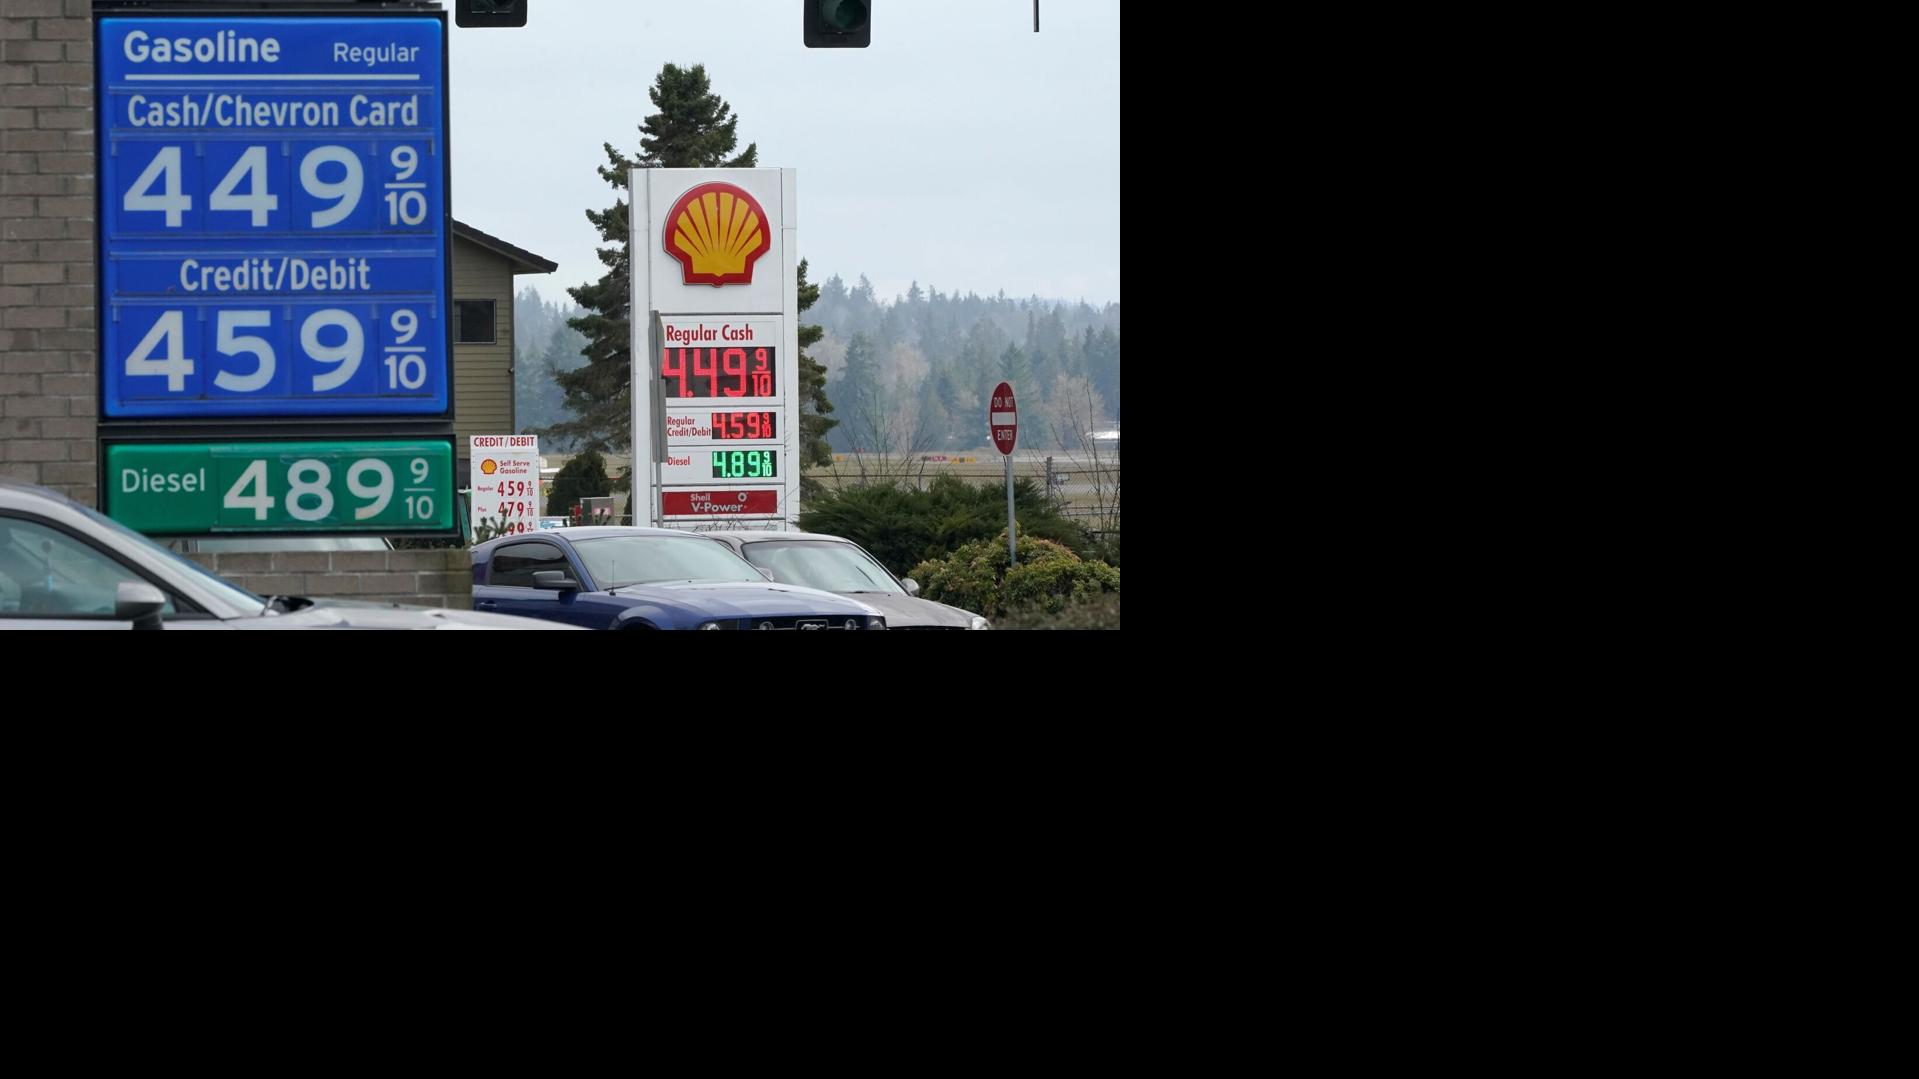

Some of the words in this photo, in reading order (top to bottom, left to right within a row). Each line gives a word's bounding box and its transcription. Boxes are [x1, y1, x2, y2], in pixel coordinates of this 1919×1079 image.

[123, 30, 280, 63] Gasoline
[333, 42, 420, 66] Regular
[127, 93, 339, 127] Cash/Chevron
[350, 95, 419, 127] Card
[123, 145, 365, 228] 449
[179, 257, 371, 291] Credit/Debit
[666, 324, 718, 345] Regular
[722, 323, 753, 341] Cash
[125, 308, 365, 392] 459
[994, 397, 1003, 408] DO
[1004, 397, 1014, 408] NOT
[667, 416, 696, 427] Regular
[667, 427, 712, 437] Credit/Debit
[712, 412, 760, 438] 4.59
[997, 429, 1013, 440] ENTER
[667, 456, 691, 466] Diesel
[713, 451, 760, 477] 4.89
[121, 468, 206, 493] Diesel
[223, 458, 395, 521] 489
[690, 493, 711, 501] Shell
[691, 502, 743, 512] V-Power
